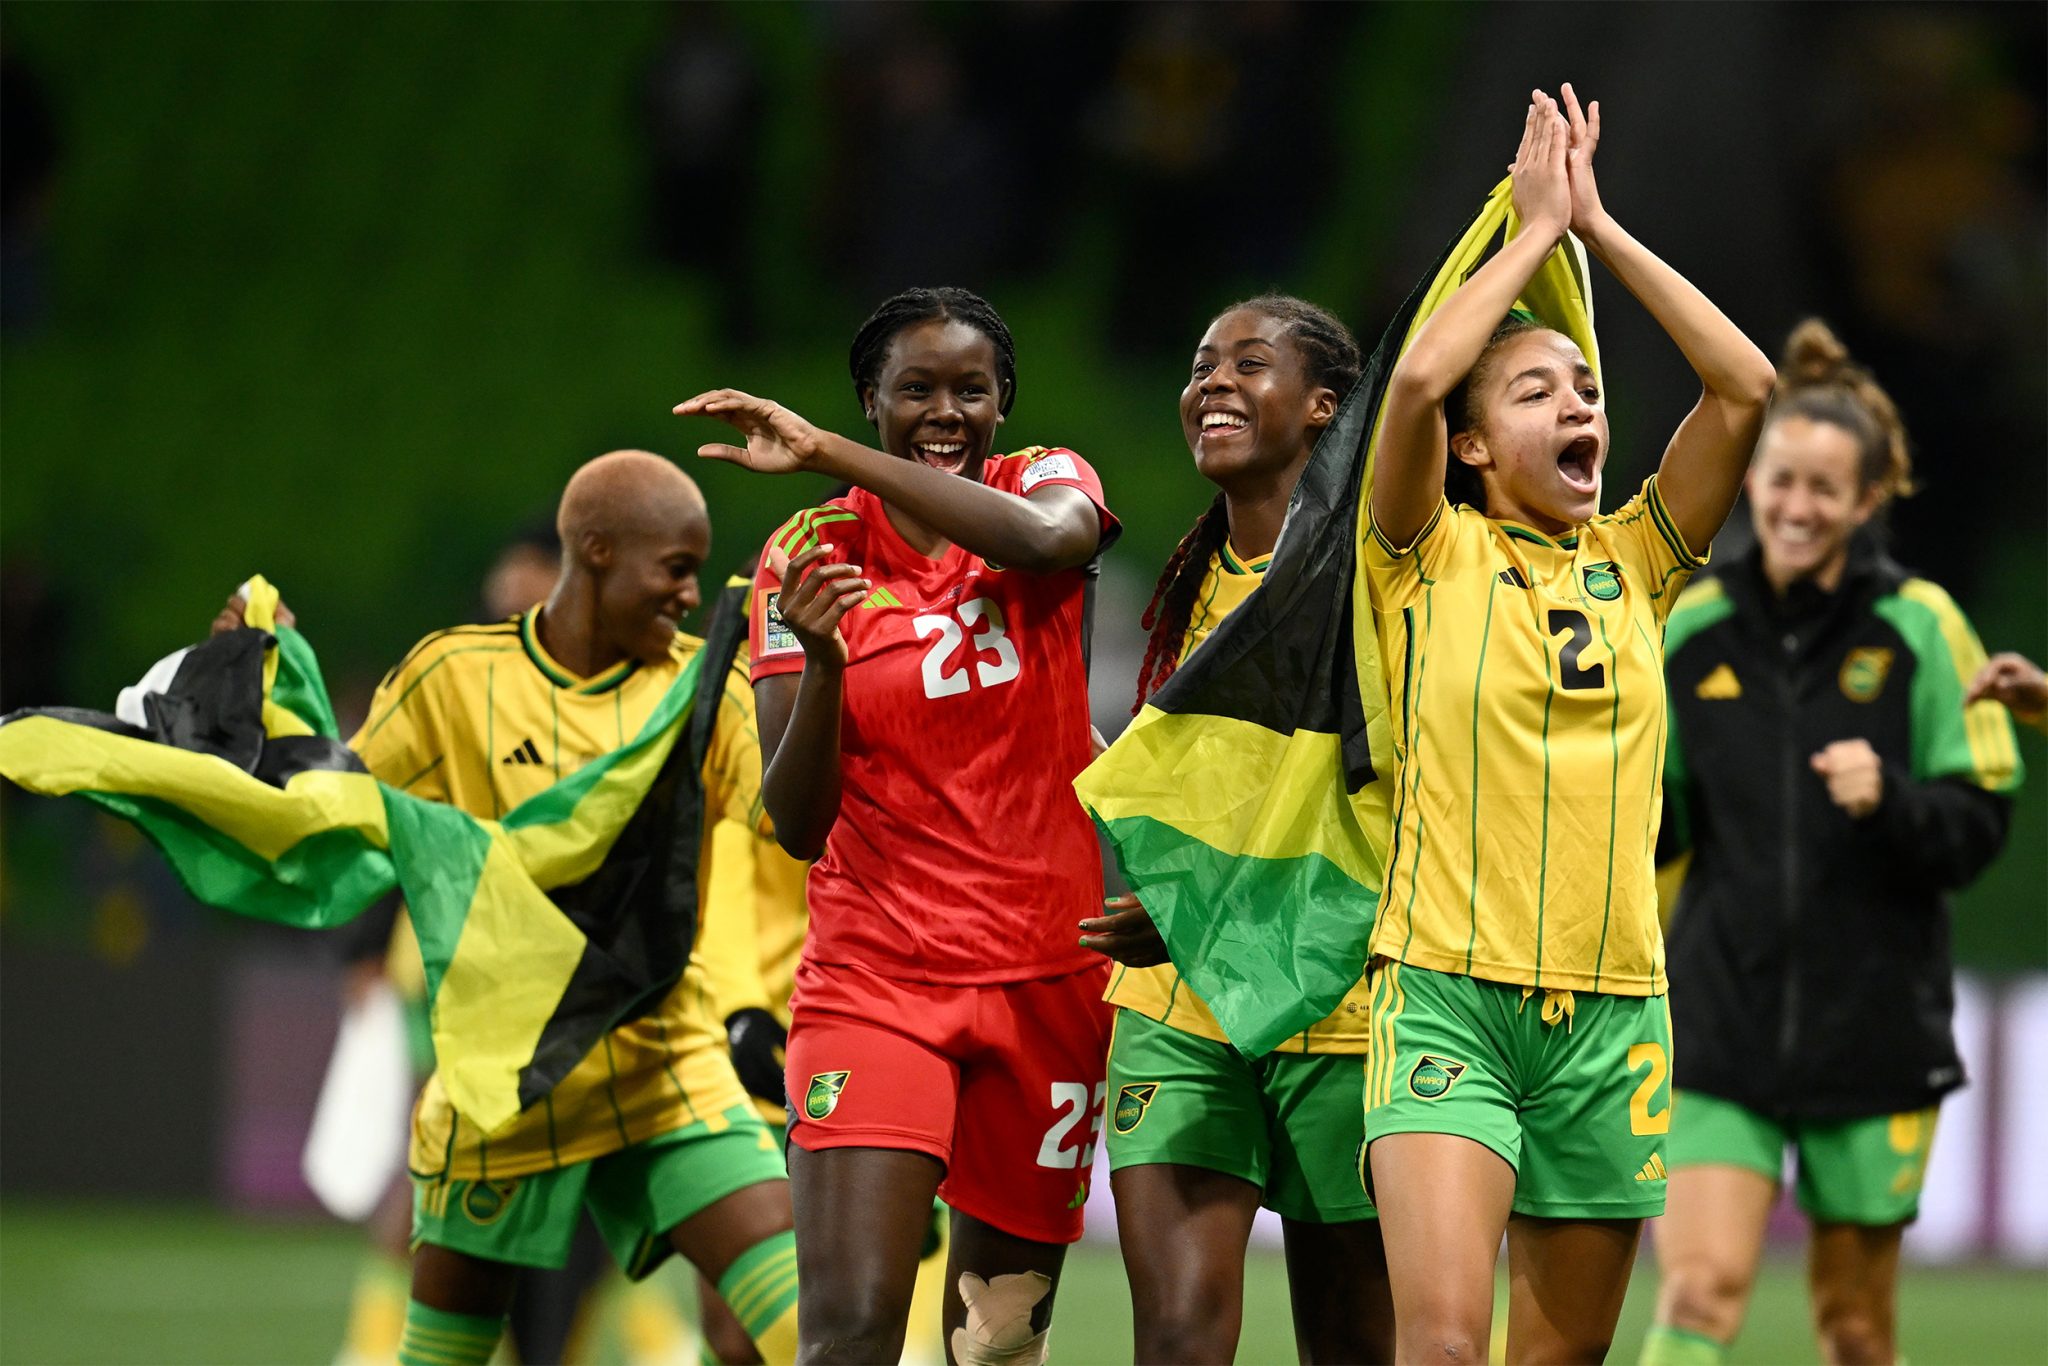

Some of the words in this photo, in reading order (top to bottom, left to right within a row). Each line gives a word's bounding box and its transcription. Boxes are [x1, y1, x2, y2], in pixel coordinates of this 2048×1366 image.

[912, 597, 1020, 699] 23
[1548, 610, 1604, 690] 2
[1414, 1075, 1446, 1086] JAMAICA
[1628, 1042, 1669, 1136] 2
